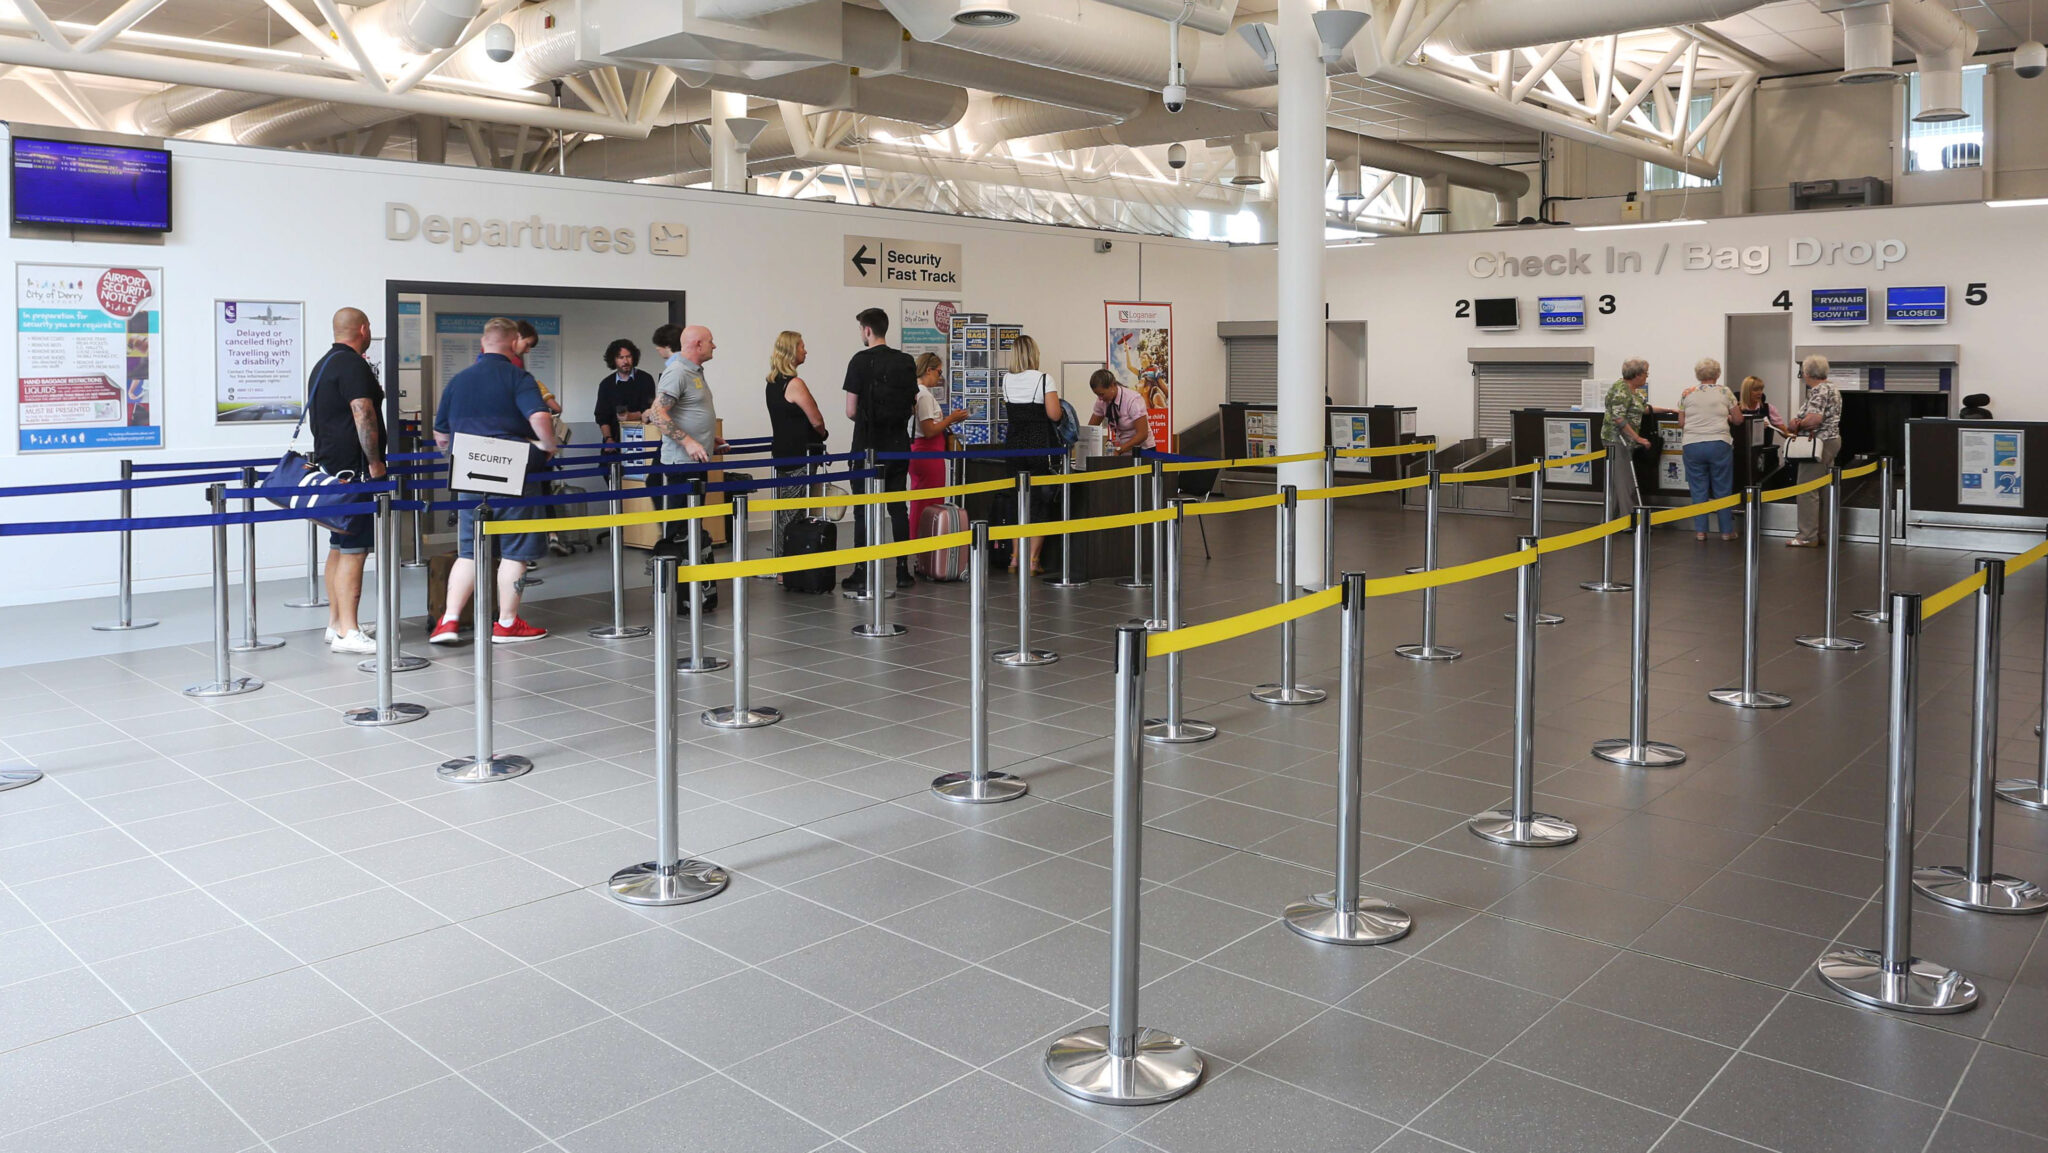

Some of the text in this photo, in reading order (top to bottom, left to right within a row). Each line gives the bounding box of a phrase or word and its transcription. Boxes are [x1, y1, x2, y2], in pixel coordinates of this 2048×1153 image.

[385, 201, 636, 254] Departures
[887, 250, 942, 268] Security
[1467, 236, 1907, 279] Check In / Bag Drop
[103, 271, 147, 288] AIRPORT
[887, 267, 957, 284] Fast Track
[26, 289, 83, 300] City of Derry
[102, 280, 150, 298] SECURITY
[1964, 282, 1989, 306] 5
[100, 290, 138, 306] NOTICE
[1598, 294, 1617, 315] 3
[1771, 289, 1794, 311] 4
[1820, 296, 1864, 304] RYANAIR
[1455, 299, 1471, 318] 2
[1896, 309, 1937, 318] CLOSED
[32, 312, 75, 321] preparation
[77, 312, 88, 320] for
[1129, 311, 1157, 320] Loganair
[22, 320, 54, 329] security
[83, 321, 112, 330] required
[236, 329, 271, 338] Delayed
[266, 338, 294, 347] flight?
[228, 349, 291, 358] Travelling with
[242, 358, 285, 367] disability?
[24, 386, 56, 394] LIQUIDS
[468, 452, 513, 465] SECURITY
